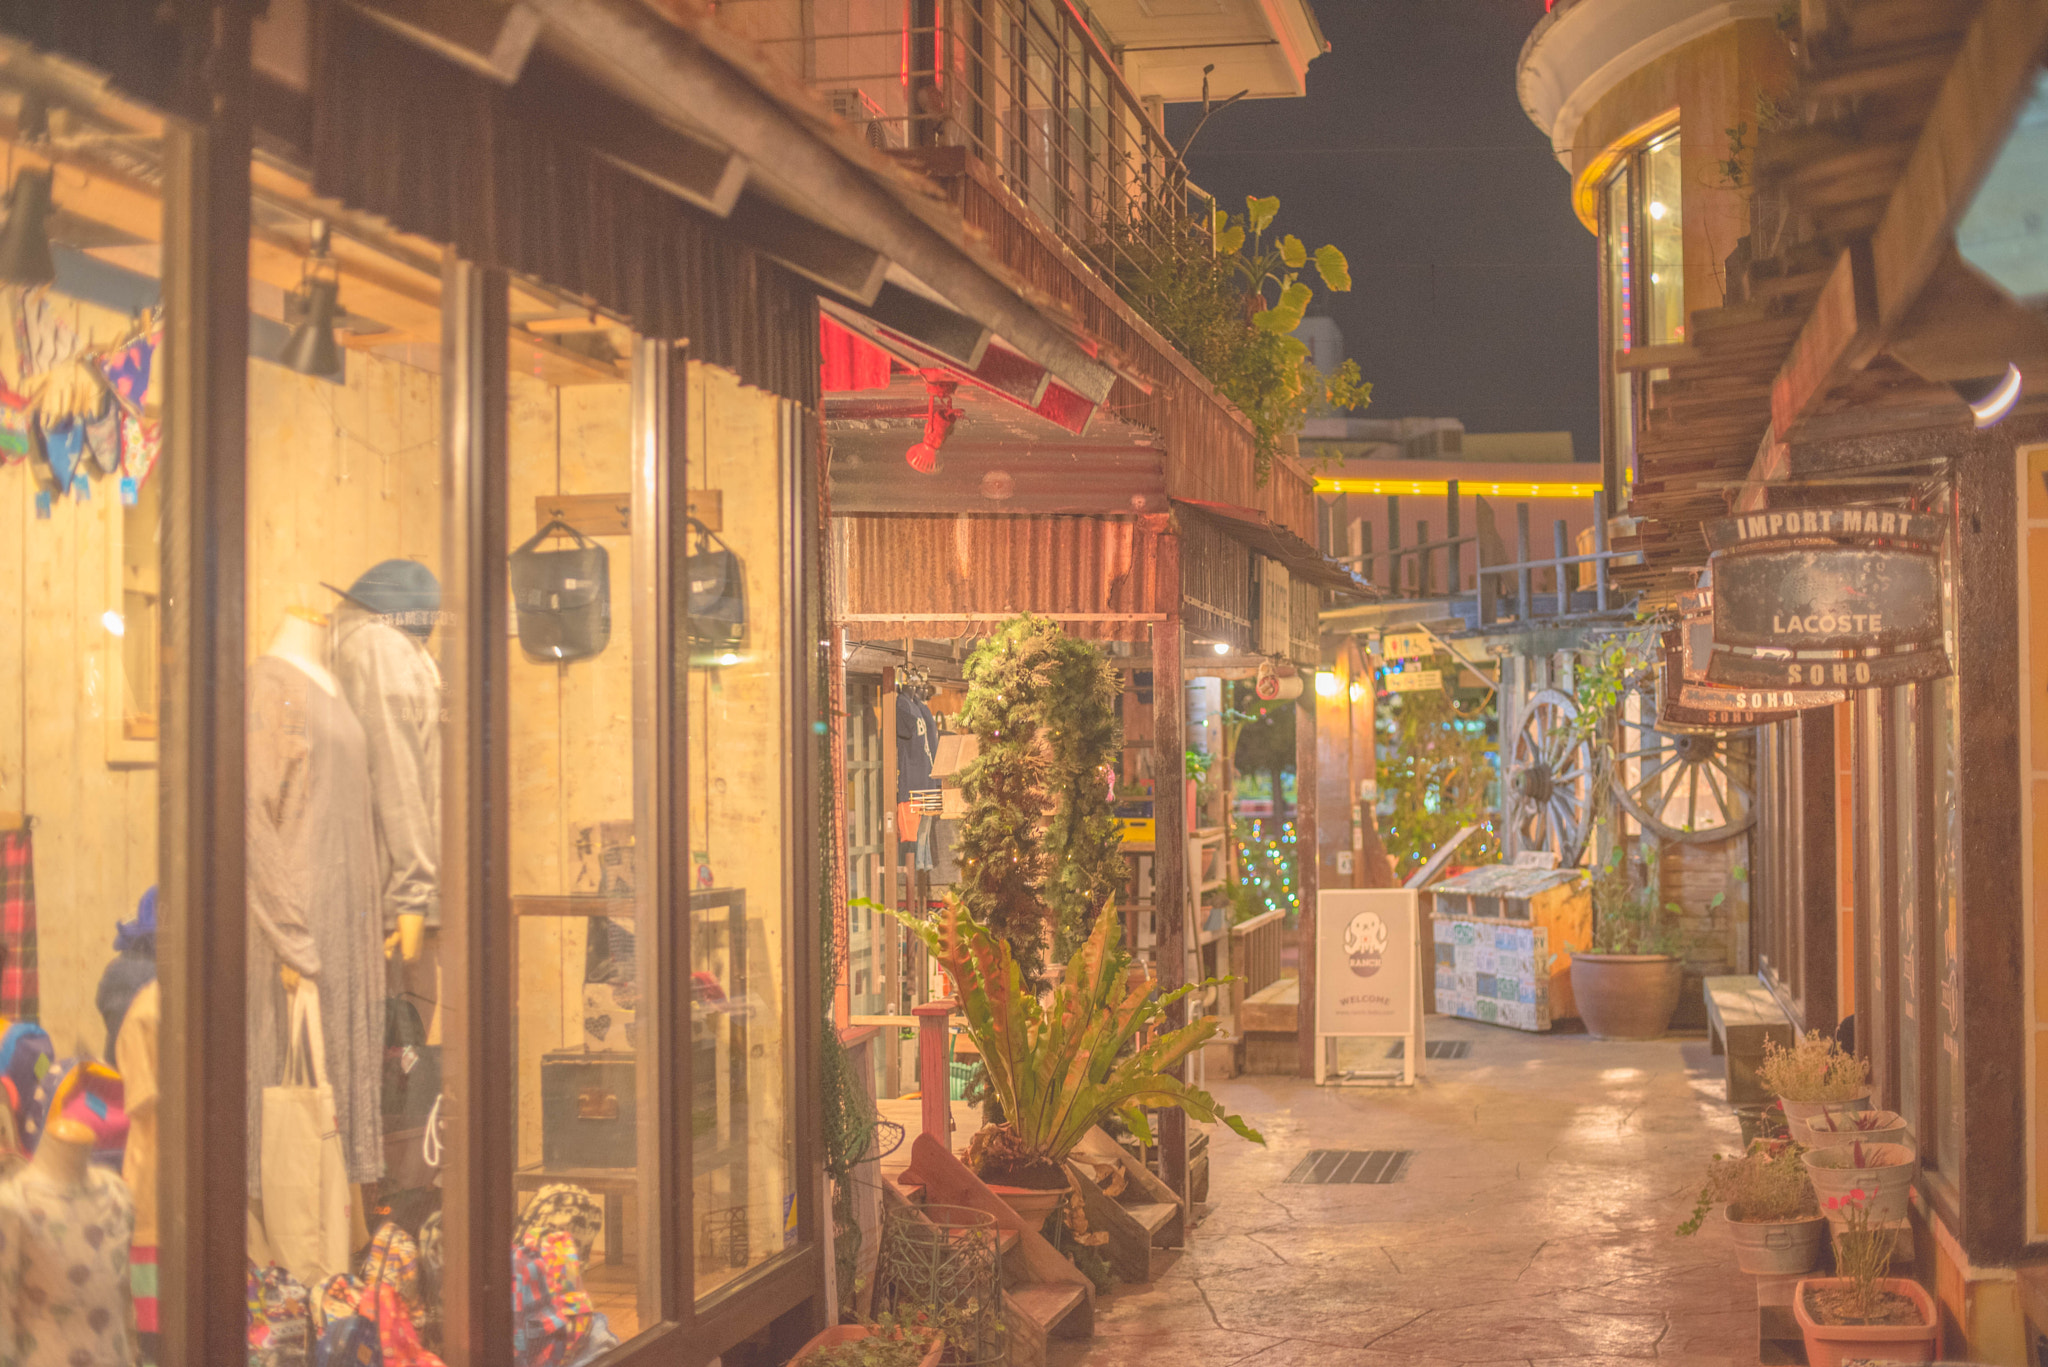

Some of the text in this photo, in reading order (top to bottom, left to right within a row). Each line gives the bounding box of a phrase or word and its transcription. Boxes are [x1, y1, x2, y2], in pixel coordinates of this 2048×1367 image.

[1737, 510, 1912, 539] IMPORT MART
[1773, 614, 1882, 634] LACOSTE
[1788, 662, 1870, 685] SOHO
[1736, 691, 1794, 709] SOHO
[1340, 995, 1391, 1006] WELCOME
